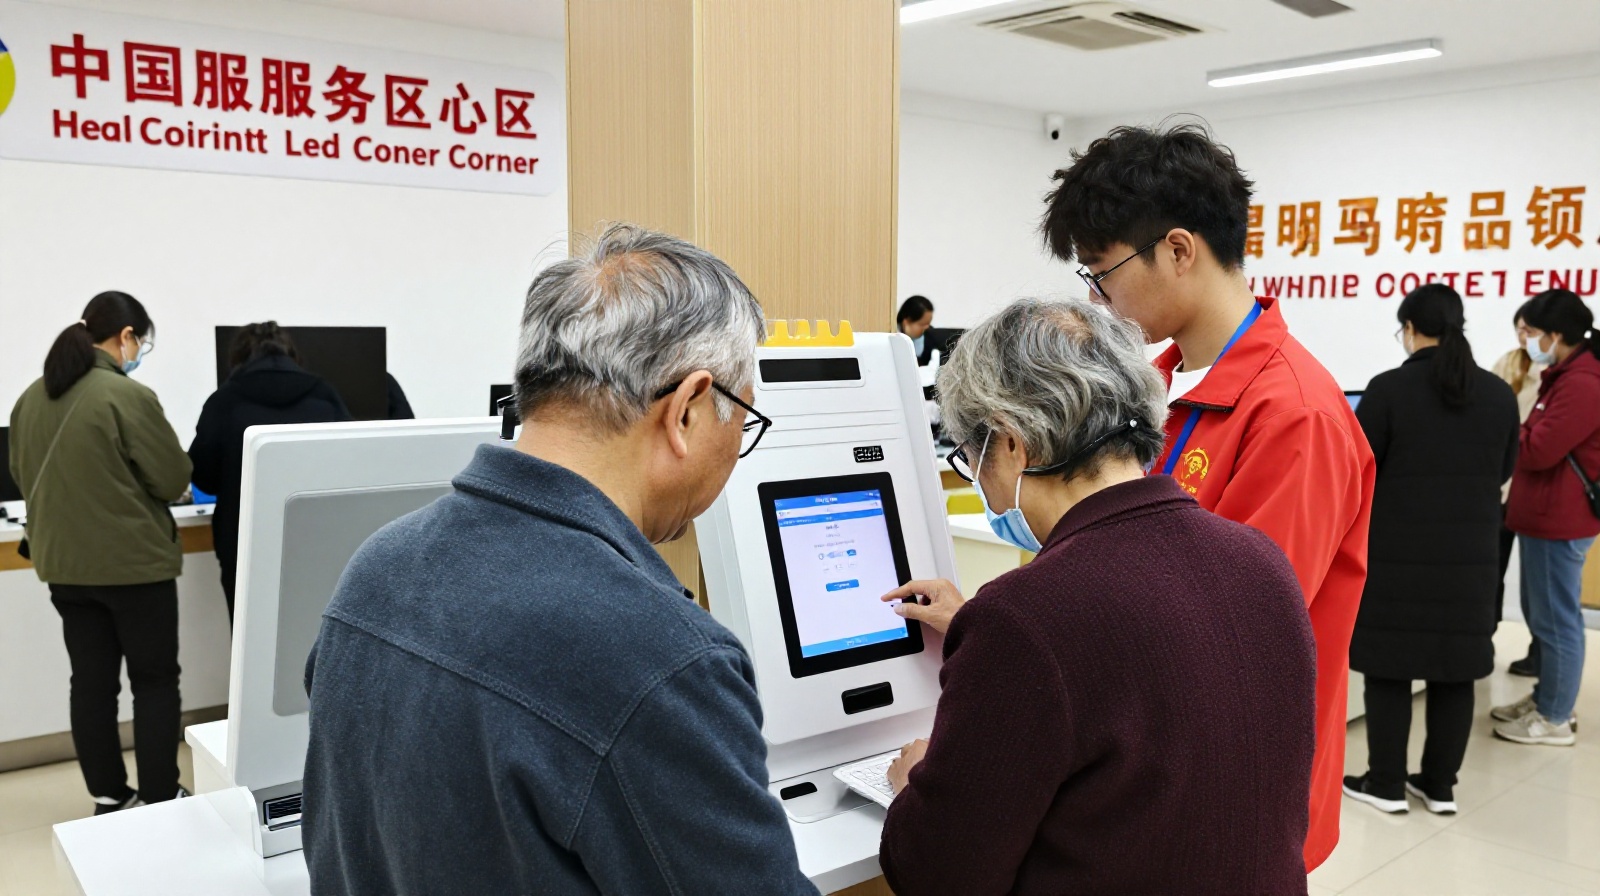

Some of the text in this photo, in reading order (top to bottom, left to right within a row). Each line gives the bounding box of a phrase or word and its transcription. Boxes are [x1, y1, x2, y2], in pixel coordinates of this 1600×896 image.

[50, 33, 537, 140] 中国服服务区心区
[53, 109, 132, 143] Heal
[285, 129, 341, 159] Led
[353, 136, 440, 167] Coner
[448, 144, 539, 175] Corner
